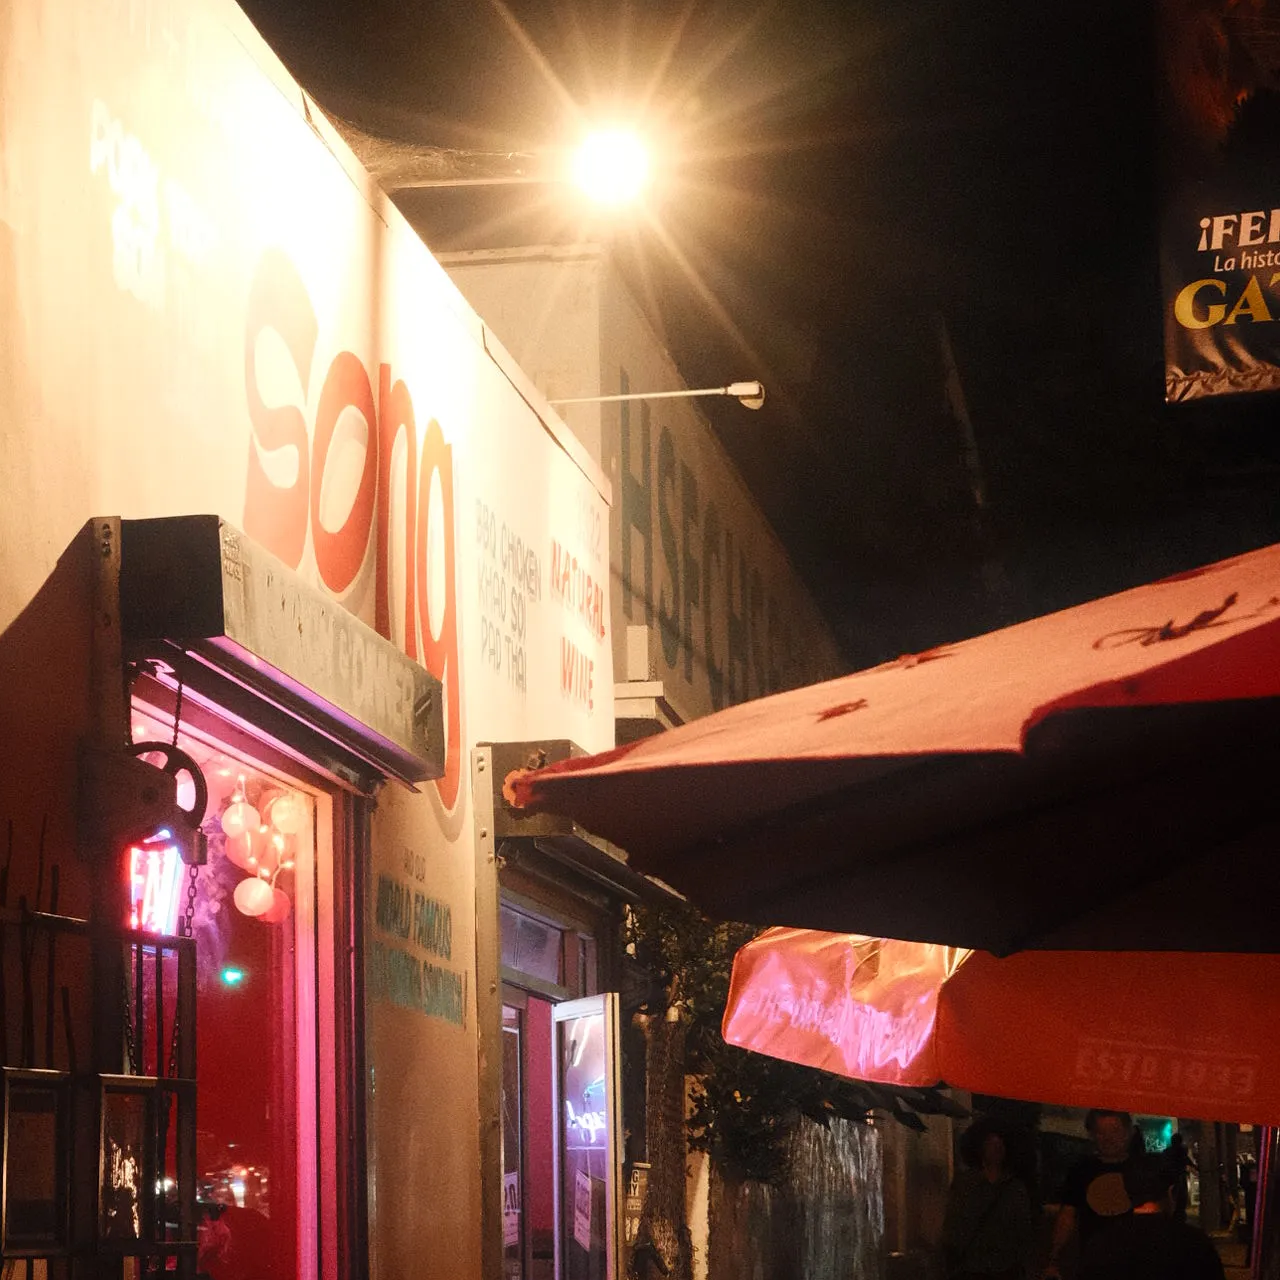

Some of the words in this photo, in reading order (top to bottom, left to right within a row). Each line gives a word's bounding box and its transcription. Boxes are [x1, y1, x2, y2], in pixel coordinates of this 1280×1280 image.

[1214, 255, 1236, 273] La
[476, 498, 497, 560] BBQ
[500, 521, 542, 602] CHICKEN
[550, 536, 605, 639] NATURAL
[478, 557, 507, 623] KHAO
[510, 586, 527, 646] SOI
[481, 614, 502, 676] PAD
[504, 634, 527, 695] THAI
[559, 636, 595, 711] WINE
